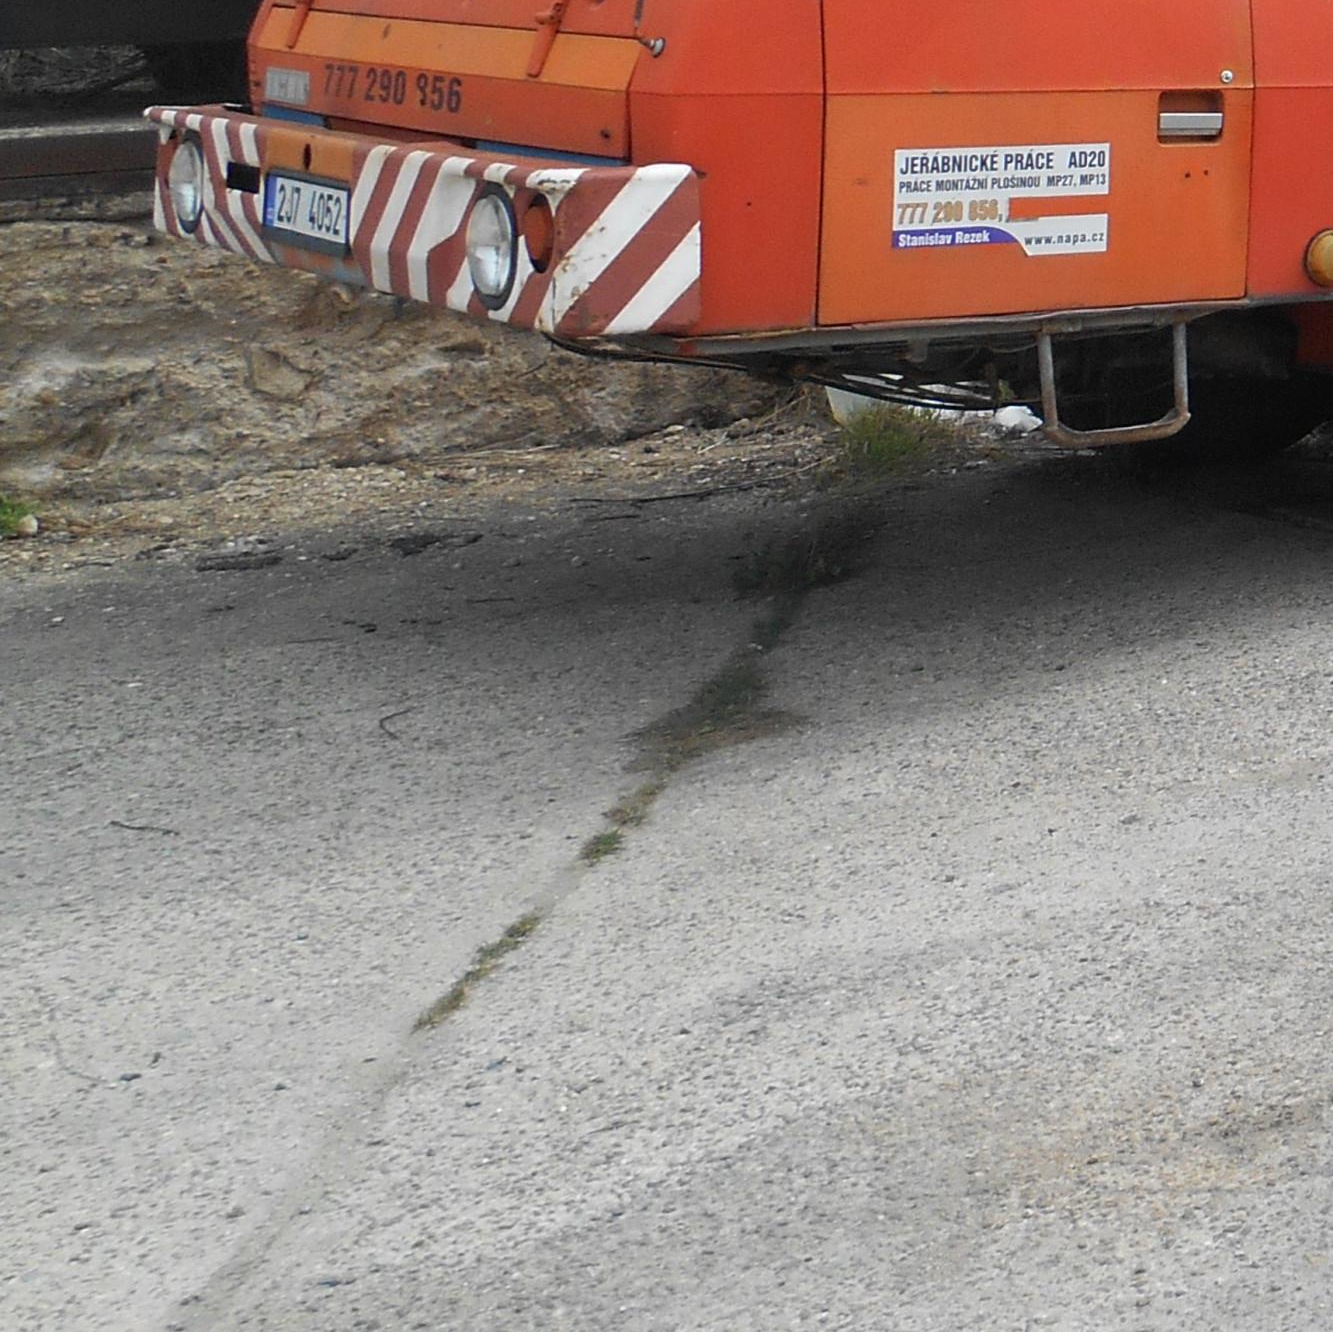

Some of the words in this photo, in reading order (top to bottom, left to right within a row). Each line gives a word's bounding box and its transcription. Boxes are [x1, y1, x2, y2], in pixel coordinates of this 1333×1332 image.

[324, 63, 359, 99] 777
[364, 67, 407, 105] 290
[900, 149, 999, 175] JEŘÁBNICKÉ
[1003, 148, 1055, 171] PRÁCE
[1068, 150, 1106, 169] AD20
[899, 178, 932, 194] PRÁCE
[991, 174, 1041, 190] PLOŠINOU
[1080, 173, 1106, 186] MP13
[277, 183, 302, 225] 2J7
[308, 189, 342, 236] 4052
[897, 201, 928, 224] 777
[898, 231, 953, 248] Stanislav
[955, 229, 991, 245] Rezek
[1024, 230, 1105, 246] www.napa.cz
